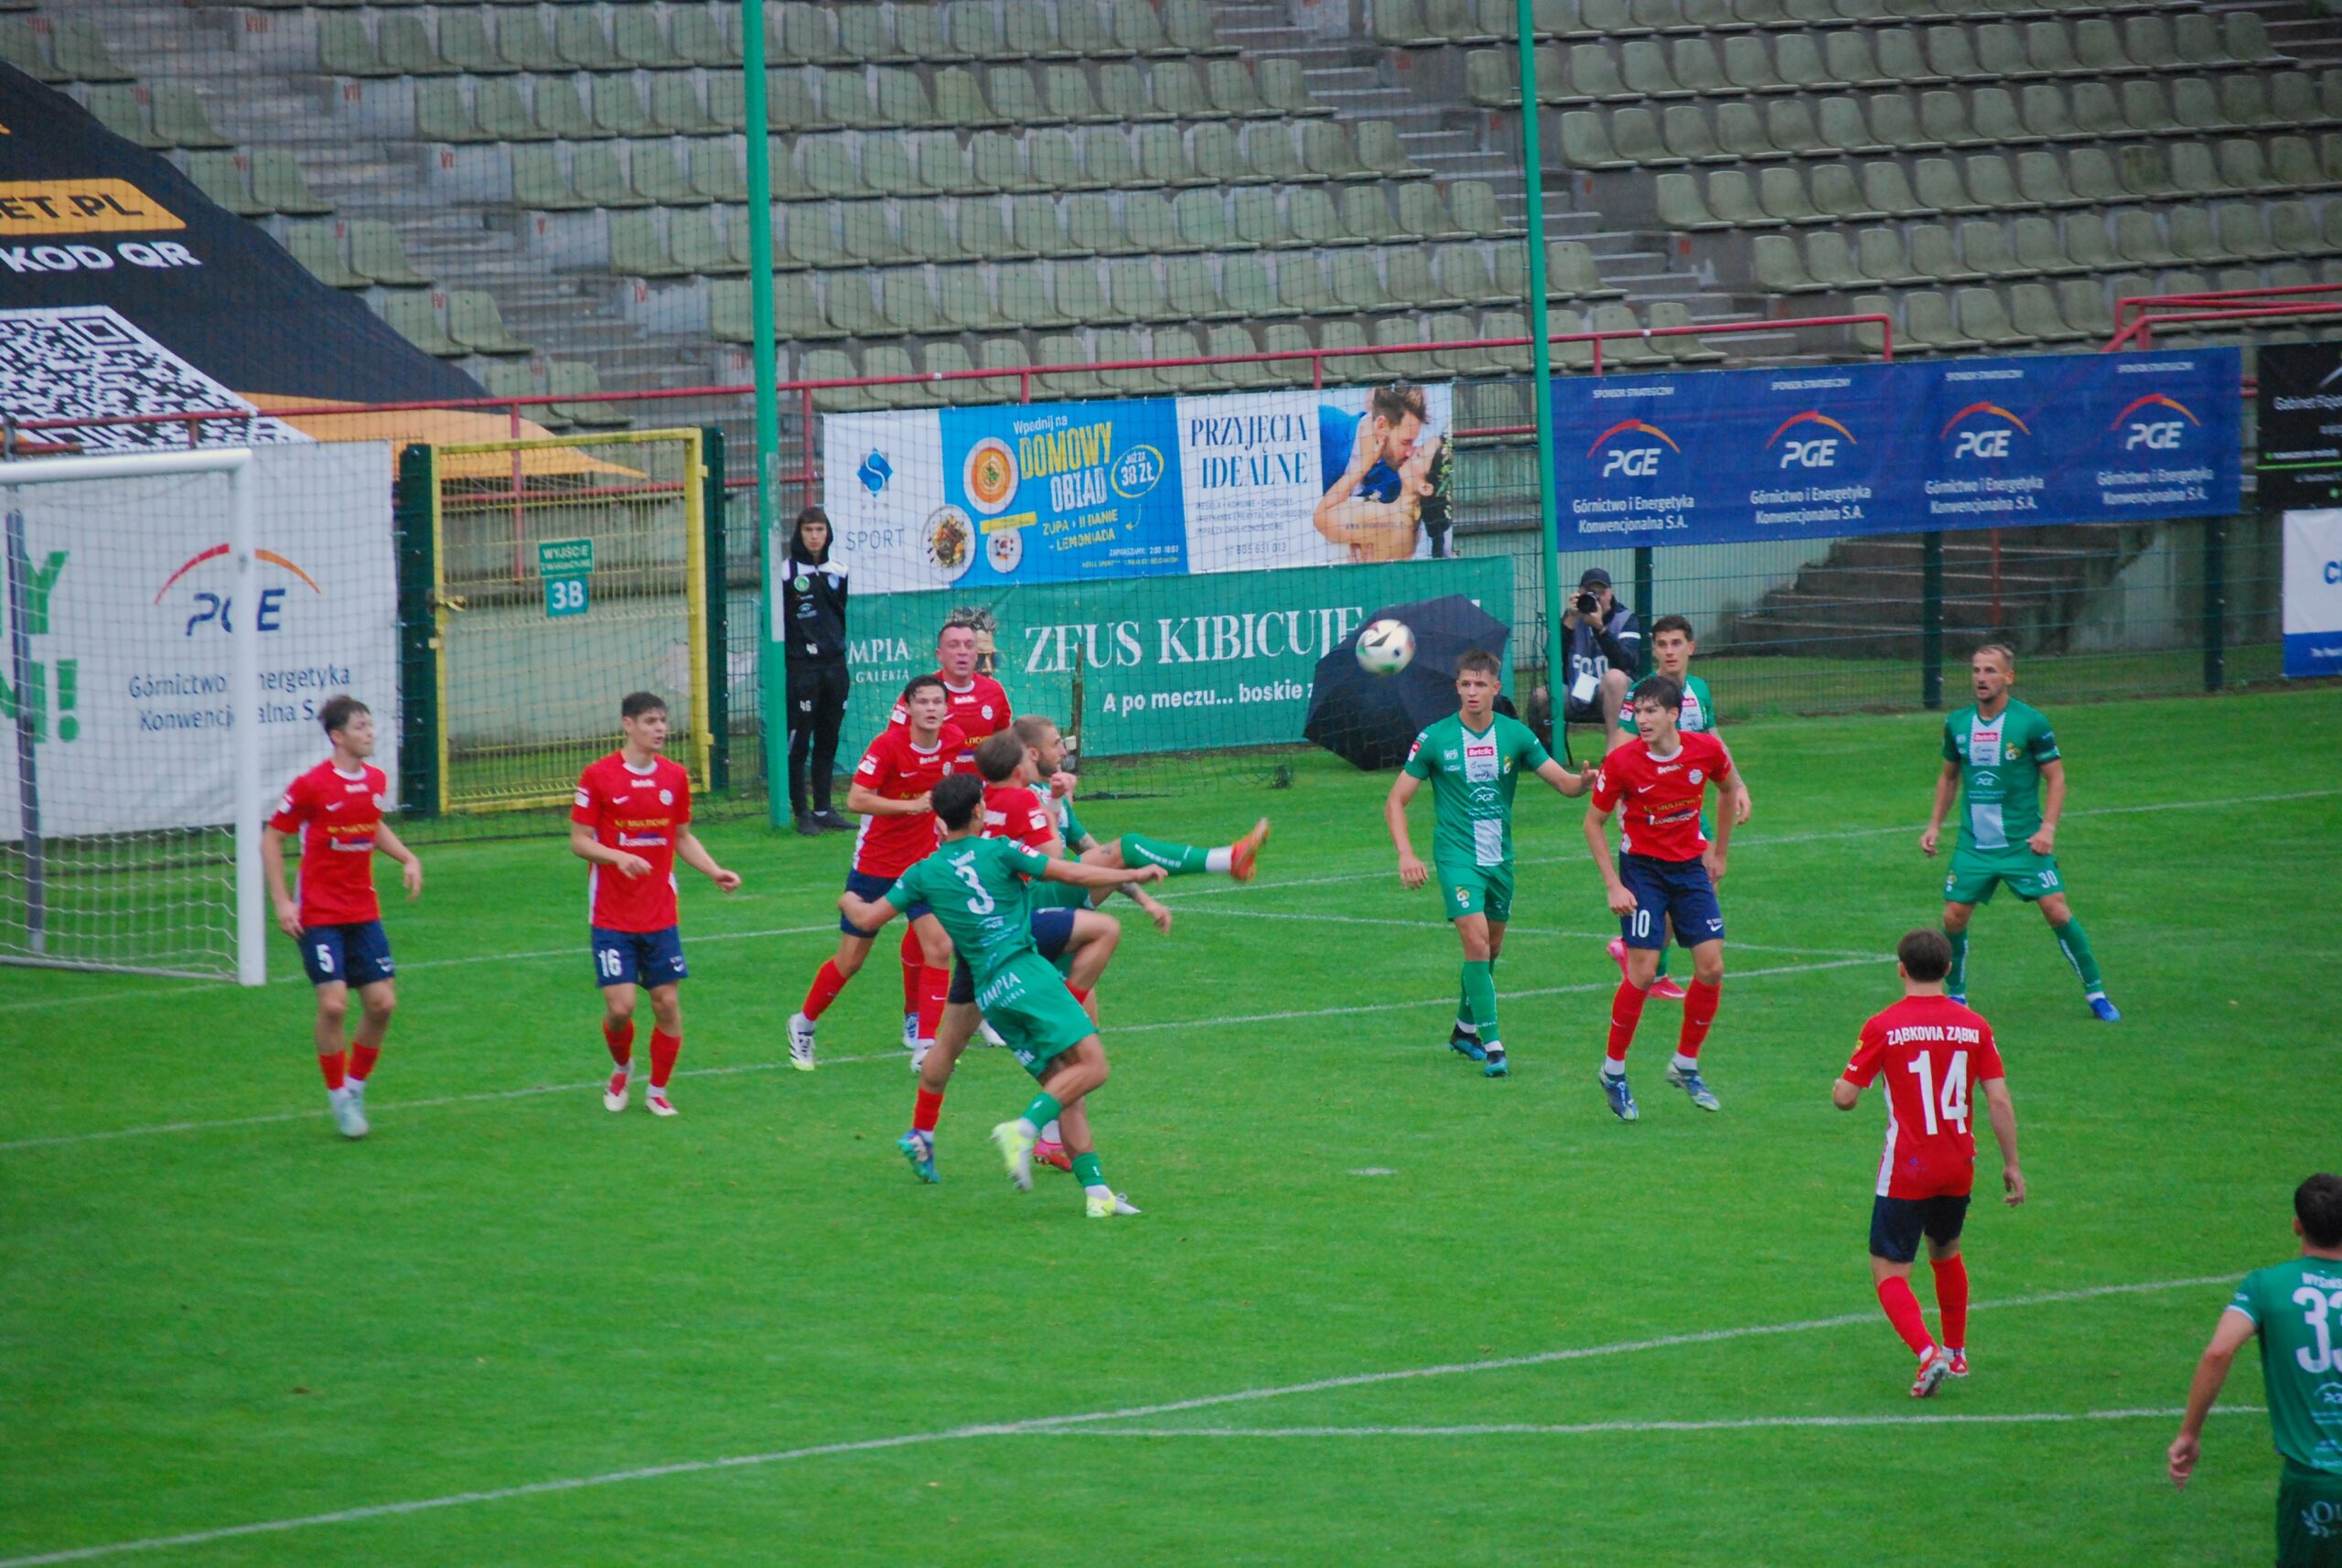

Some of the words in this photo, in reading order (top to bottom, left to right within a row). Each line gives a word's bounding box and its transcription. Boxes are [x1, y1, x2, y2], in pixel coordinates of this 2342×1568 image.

[0, 194, 144, 220] ET.PL
[0, 244, 114, 273] KOD
[117, 241, 203, 268] QR
[1014, 415, 1054, 435] Wpadnij
[1056, 415, 1068, 427] na
[1191, 414, 1307, 454] PRZYJĘCIA
[2125, 422, 2185, 450] PGE
[1019, 421, 1112, 480] DOMOWY
[1780, 439, 1838, 468] PGE
[1954, 430, 2012, 458] PGE
[1139, 461, 1155, 483] ZŁ
[1202, 452, 1308, 489] IDEALNE
[1603, 448, 1661, 477] PGE
[1050, 467, 1108, 512] OBIAD
[1574, 499, 1627, 513] Górnictwo
[1636, 494, 1695, 511] Energetyka
[1750, 489, 1804, 504] Górnictwo
[1812, 485, 1872, 502] Energetyka
[1042, 521, 1069, 536] ZUPA
[1579, 516, 1663, 534] Konwencjonalna
[1666, 515, 1688, 529] S.A.
[1756, 509, 1840, 524] Konwencjonalna
[1842, 506, 1864, 520] S.A.
[845, 528, 905, 551] SPORT
[1057, 528, 1115, 551] LEMONIADA
[848, 638, 910, 665] MPIA
[1025, 621, 1143, 673] ZEUS
[129, 673, 226, 699] Górnictwo
[259, 663, 351, 693] nergetyka
[855, 669, 910, 683] GALERIA
[1102, 693, 1117, 713] A
[1122, 693, 1144, 716] po
[1151, 688, 1233, 708] meczu...
[1239, 679, 1302, 703] boskie
[955, 865, 996, 915] 3
[2038, 869, 2058, 889] 30
[1630, 909, 1650, 938] 10
[316, 944, 334, 973] 5
[598, 949, 622, 978] 16
[1886, 1026, 1944, 1046] ZĄBKOVIA
[1946, 1026, 1980, 1045] ZĄBKI
[1907, 1049, 1969, 1135] 14
